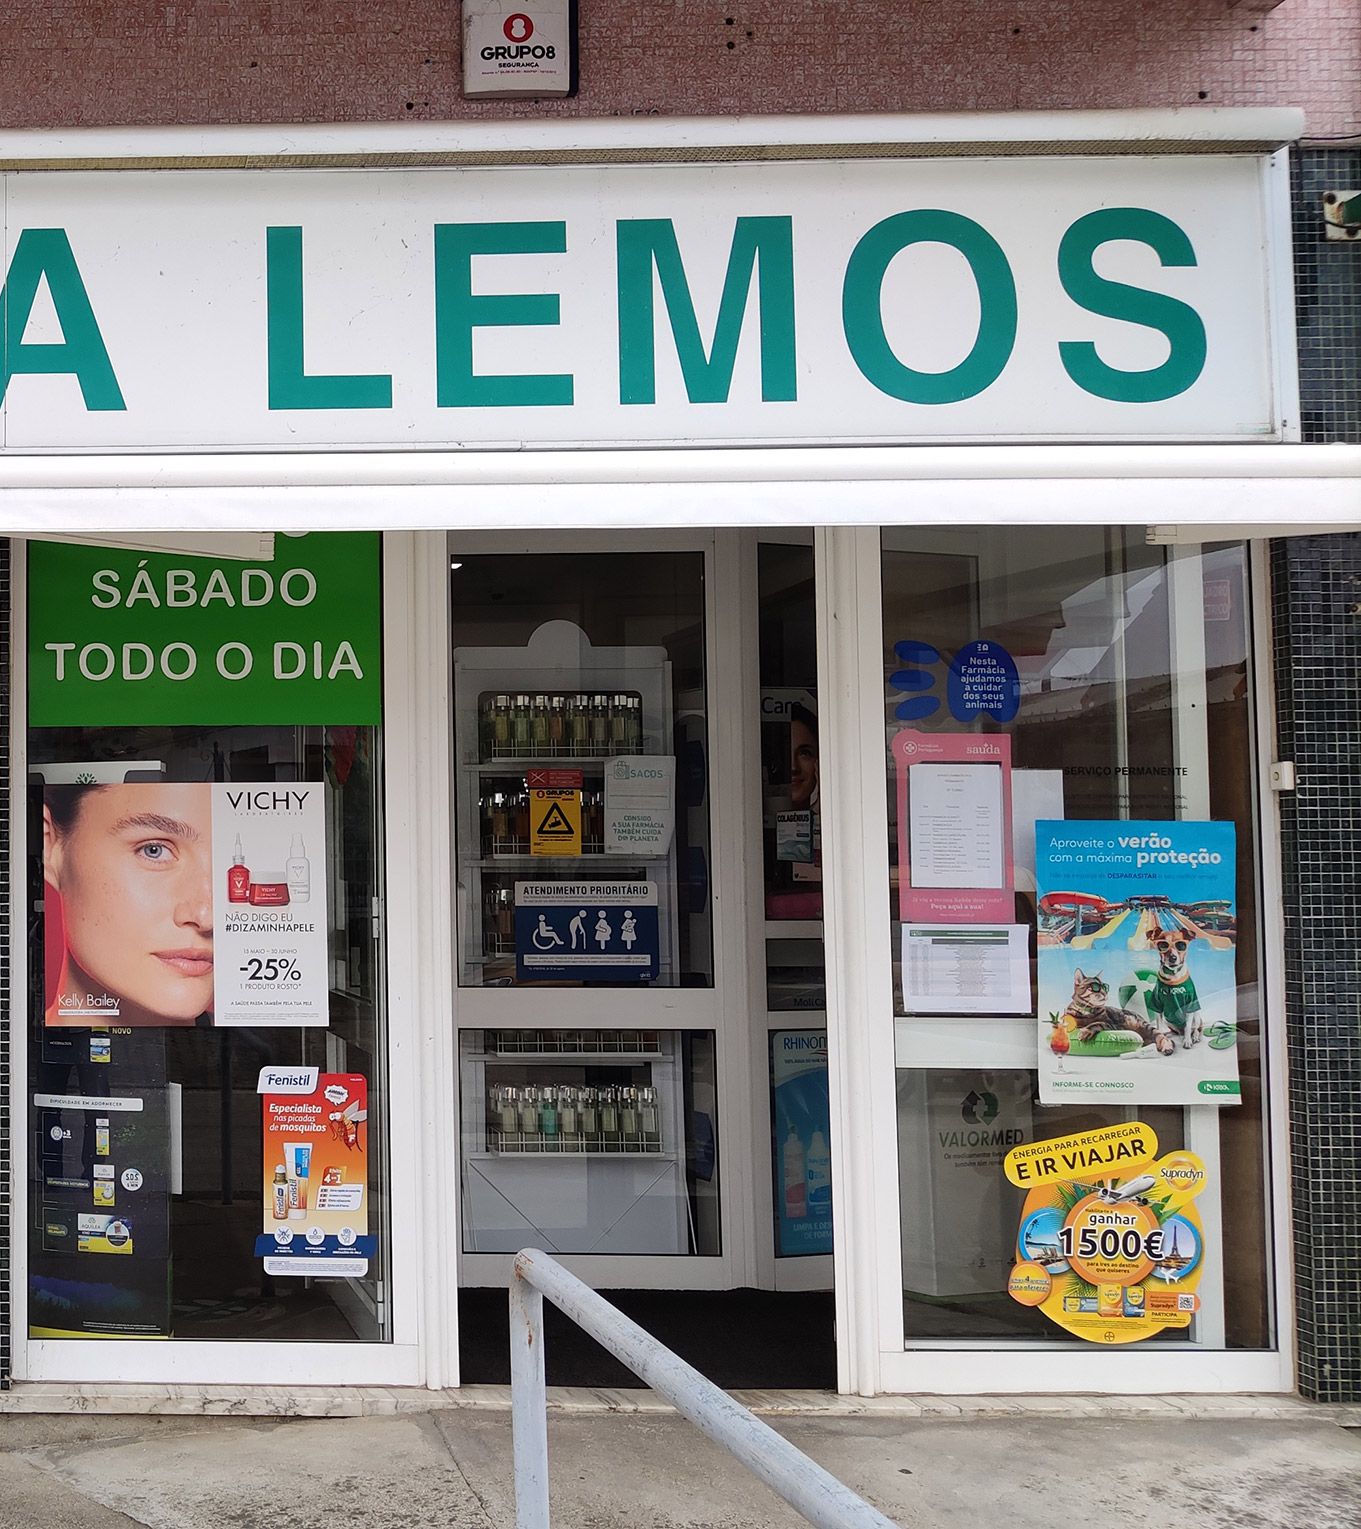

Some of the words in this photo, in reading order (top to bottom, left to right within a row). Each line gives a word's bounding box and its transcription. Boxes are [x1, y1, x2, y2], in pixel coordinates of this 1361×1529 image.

[481, 45, 556, 60] GRUPO8
[267, 206, 1208, 411] LEMOS
[91, 560, 317, 608] SÁBADO
[44, 641, 197, 681] TODO
[216, 641, 253, 681] O
[273, 640, 364, 681] DIA
[970, 657, 997, 665] Nesta
[961, 666, 1006, 674] Farmácia
[960, 675, 1006, 684] ajudamos
[972, 683, 1002, 691] cuidar
[963, 692, 980, 700] dos
[965, 701, 1002, 709] animais
[630, 769, 663, 779] SACOS
[1064, 767, 1112, 777] SERVIÇO
[1114, 767, 1188, 776] PERMANENTE
[226, 791, 310, 810] VICHY
[631, 820, 665, 828] FARMÁCIA
[1049, 837, 1104, 850] Aproveite
[1118, 832, 1172, 849] verão
[1049, 854, 1073, 863] com
[1086, 852, 1132, 863] máxima
[1136, 848, 1222, 868] proteção
[523, 886, 587, 895] ATENDIMENTO
[590, 884, 649, 895] PRIORITÁRIO
[225, 911, 249, 922] NÃO
[251, 913, 278, 922] DIGO
[281, 913, 293, 922] EU
[225, 923, 315, 932] #DIZAMINHAPELE
[239, 958, 301, 981] -25%
[58, 994, 83, 1009] Kelly
[86, 993, 120, 1009] Bailey
[112, 1027, 132, 1035] NOVO
[265, 1073, 311, 1086] Fenistil
[269, 1103, 322, 1114] Especialista
[287, 1114, 316, 1123] picadas
[280, 1123, 327, 1134] mosquitos
[938, 1129, 1024, 1148] VALORMED
[1013, 1146, 1053, 1160] ENERGIA
[1054, 1140, 1080, 1151] PARA
[1080, 1126, 1142, 1146] RECARREGAR
[1016, 1163, 1031, 1181] E
[1036, 1157, 1059, 1177] IR
[1062, 1138, 1148, 1171] VIAJAR
[1160, 1167, 1204, 1181] Supradyn
[1089, 1213, 1137, 1226] ganhar
[1059, 1227, 1164, 1260] 1500€
